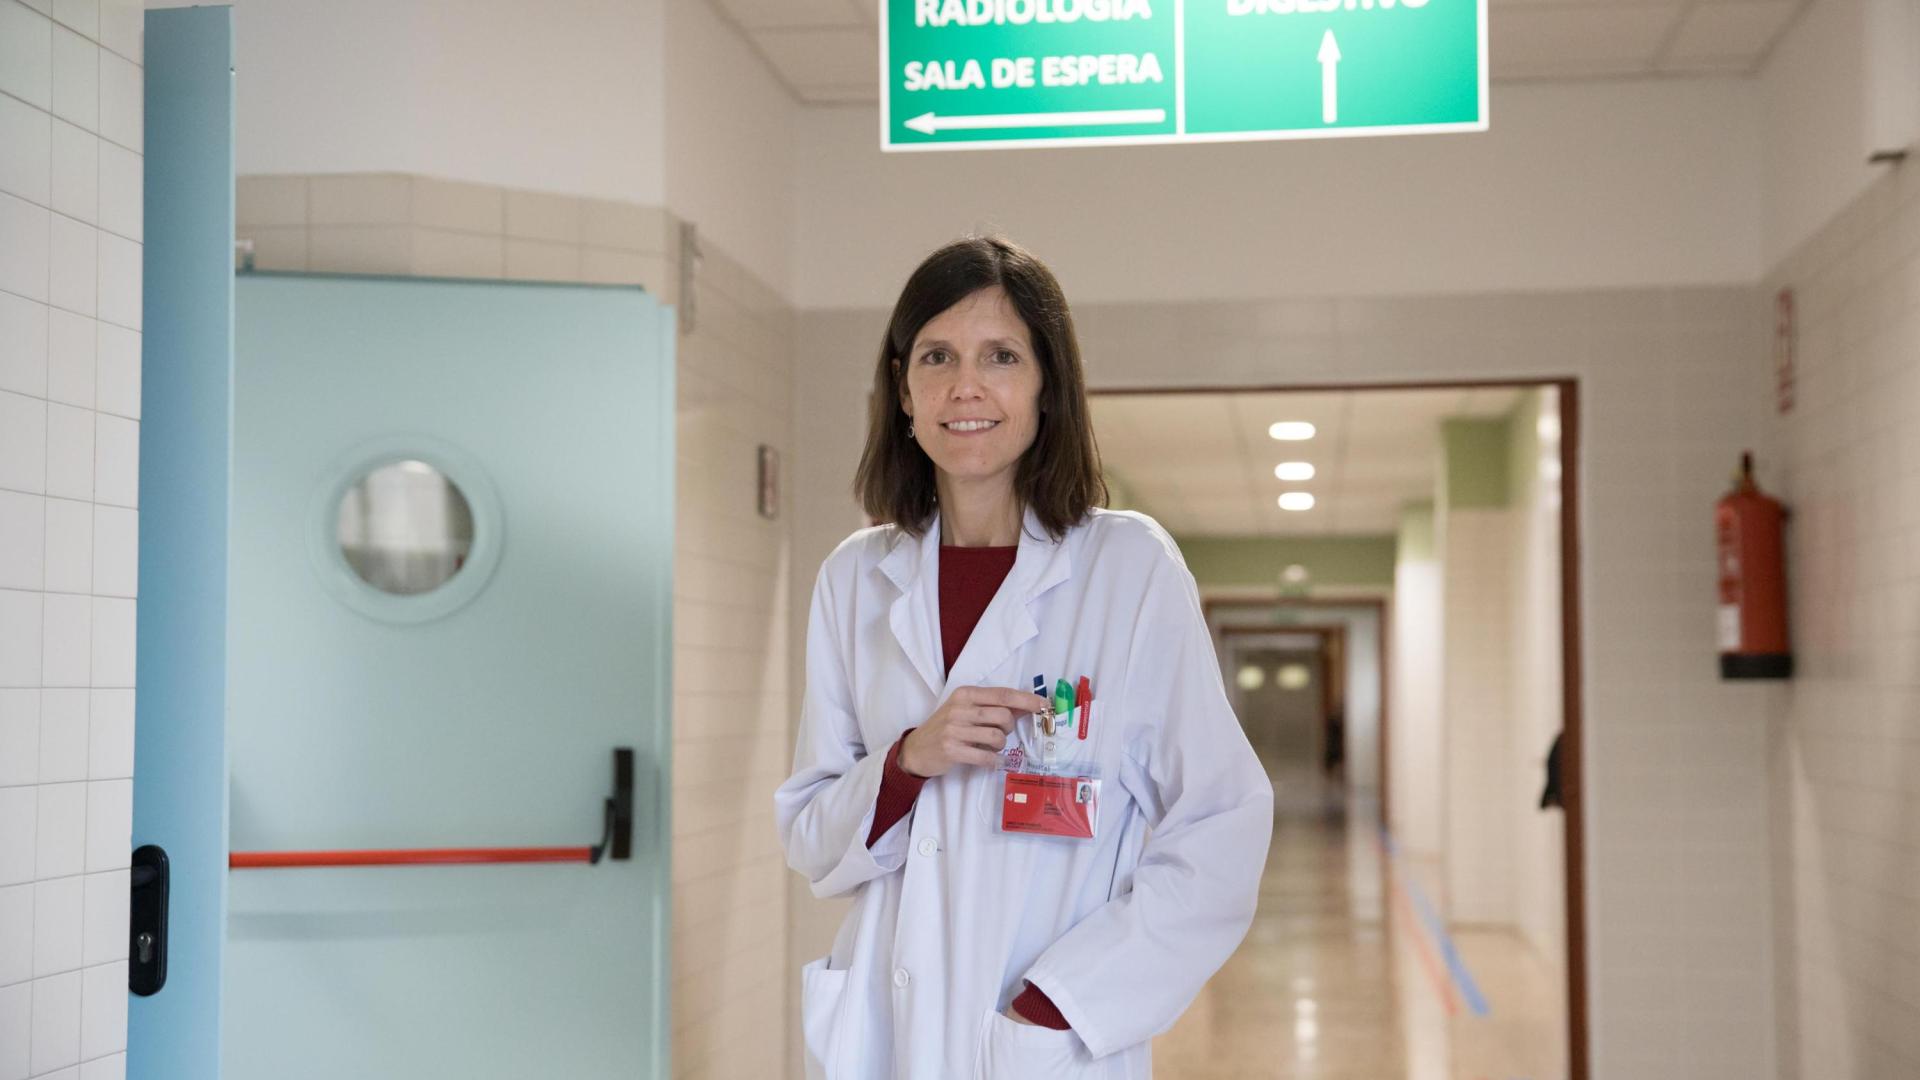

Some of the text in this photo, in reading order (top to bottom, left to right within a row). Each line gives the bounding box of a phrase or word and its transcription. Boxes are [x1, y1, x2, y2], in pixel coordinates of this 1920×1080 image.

[903, 53, 1163, 91] SALA DE ESPERA
